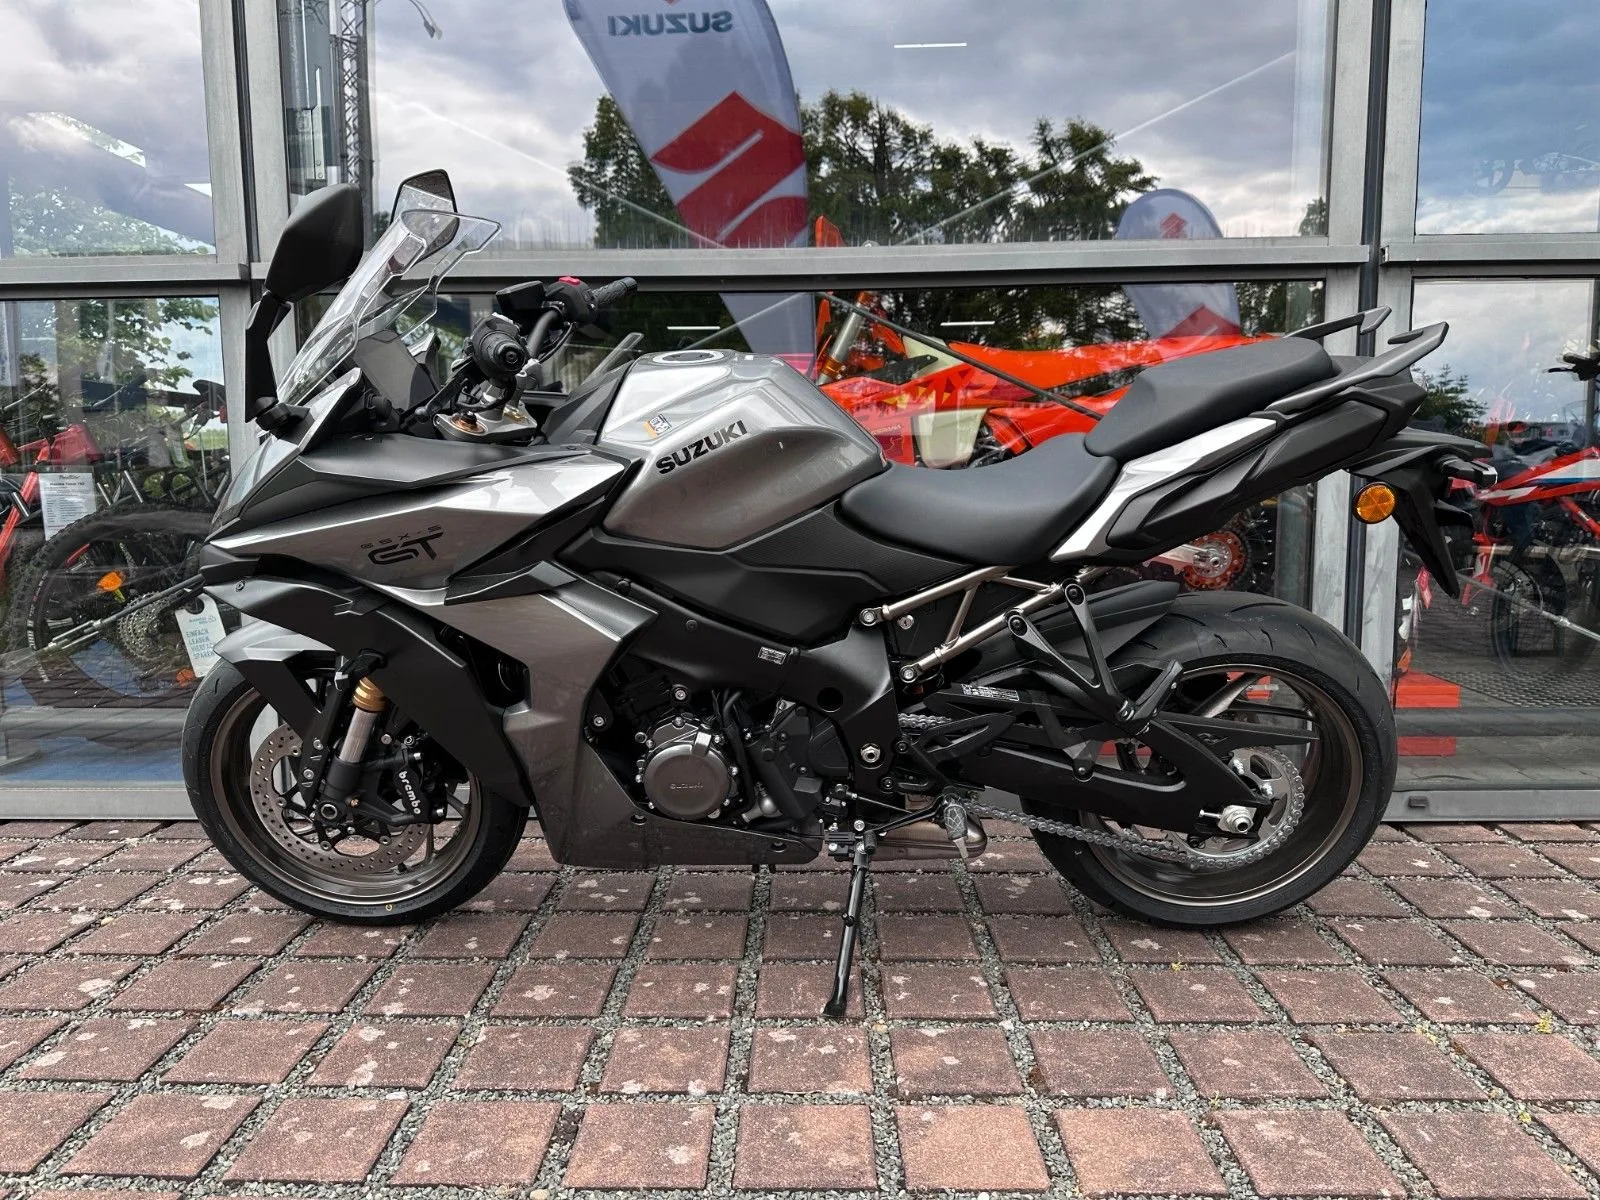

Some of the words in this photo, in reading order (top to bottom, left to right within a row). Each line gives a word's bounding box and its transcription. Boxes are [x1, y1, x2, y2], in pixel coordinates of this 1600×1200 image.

[655, 419, 748, 475] SUZUKI
[360, 524, 442, 549] GSX-S
[367, 532, 444, 565] GT
[399, 771, 421, 814] brembo
